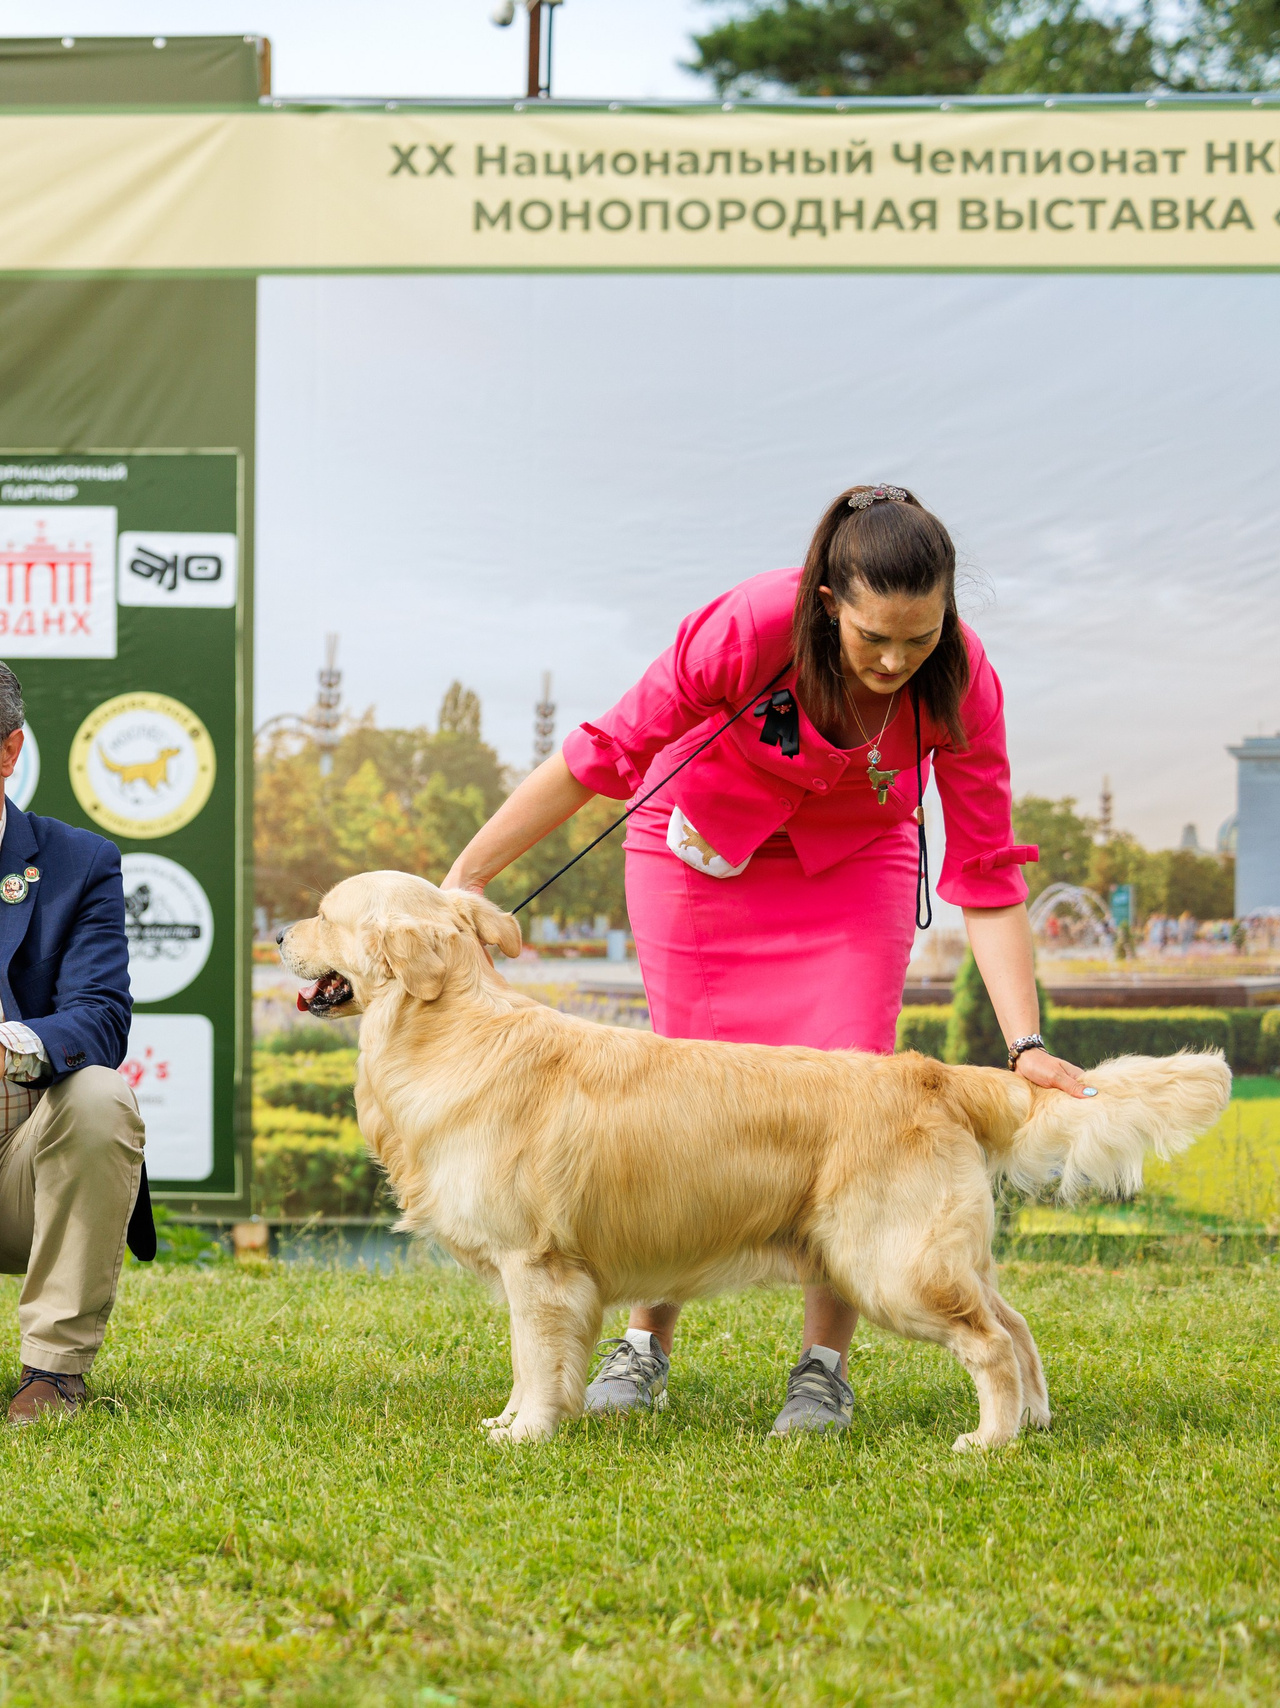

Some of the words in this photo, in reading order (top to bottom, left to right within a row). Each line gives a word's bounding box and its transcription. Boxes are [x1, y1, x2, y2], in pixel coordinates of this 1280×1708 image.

[475, 138, 873, 182] Национальный
[891, 141, 1188, 176] Чемпионат
[1203, 141, 1280, 174] НК
[473, 197, 938, 237] МОНОПОРОДНАЯ
[958, 197, 1255, 231] ВЫСТАВКА
[1, 484, 78, 502] ПАРТНЕР
